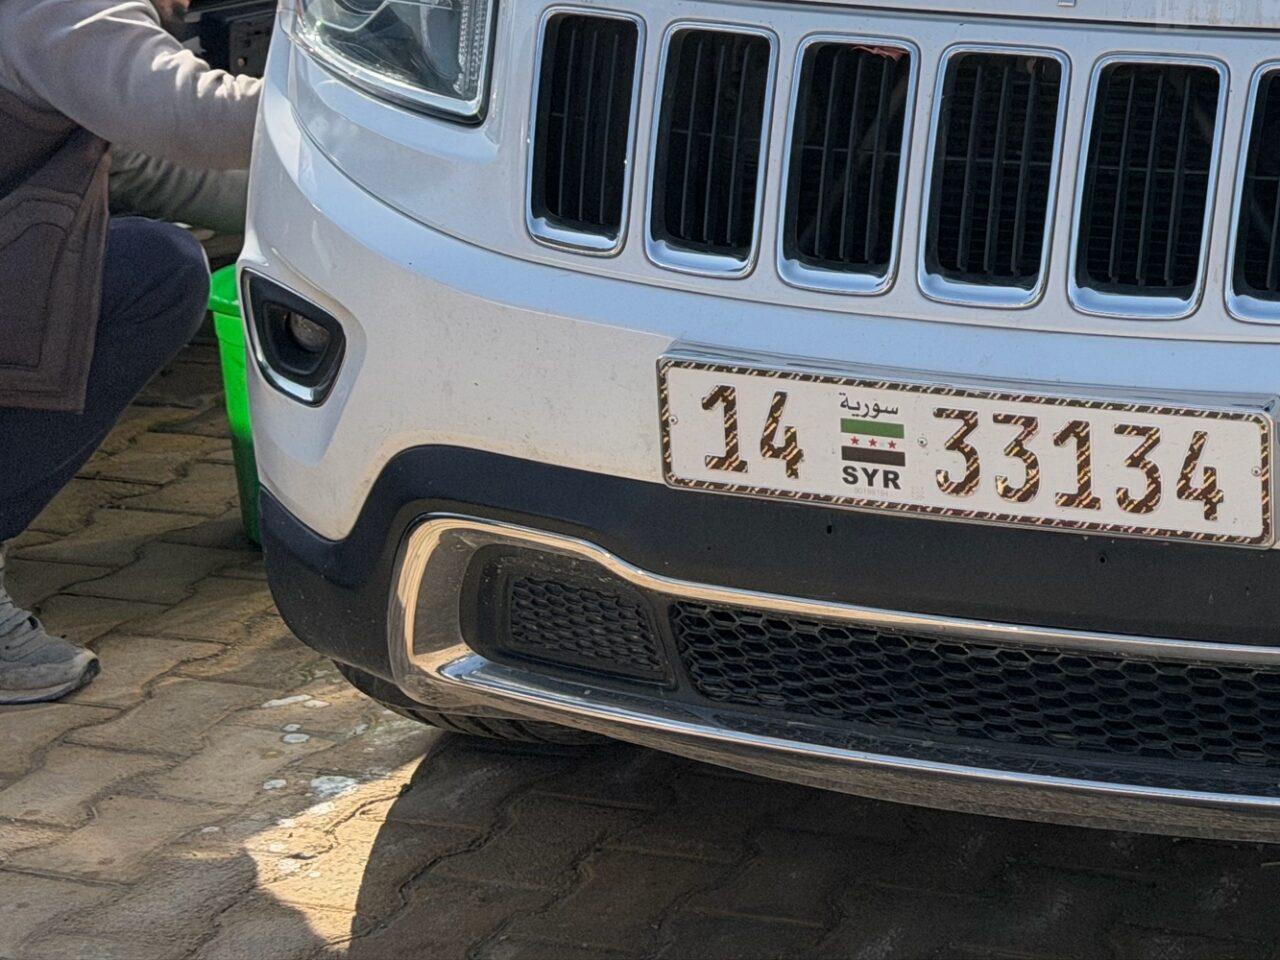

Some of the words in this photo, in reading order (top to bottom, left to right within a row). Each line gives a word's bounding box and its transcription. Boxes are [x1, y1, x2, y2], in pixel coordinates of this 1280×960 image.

[838, 391, 899, 419] سورية
[701, 384, 804, 480] 14
[932, 406, 1225, 522] 33134
[841, 465, 902, 491] SYR
